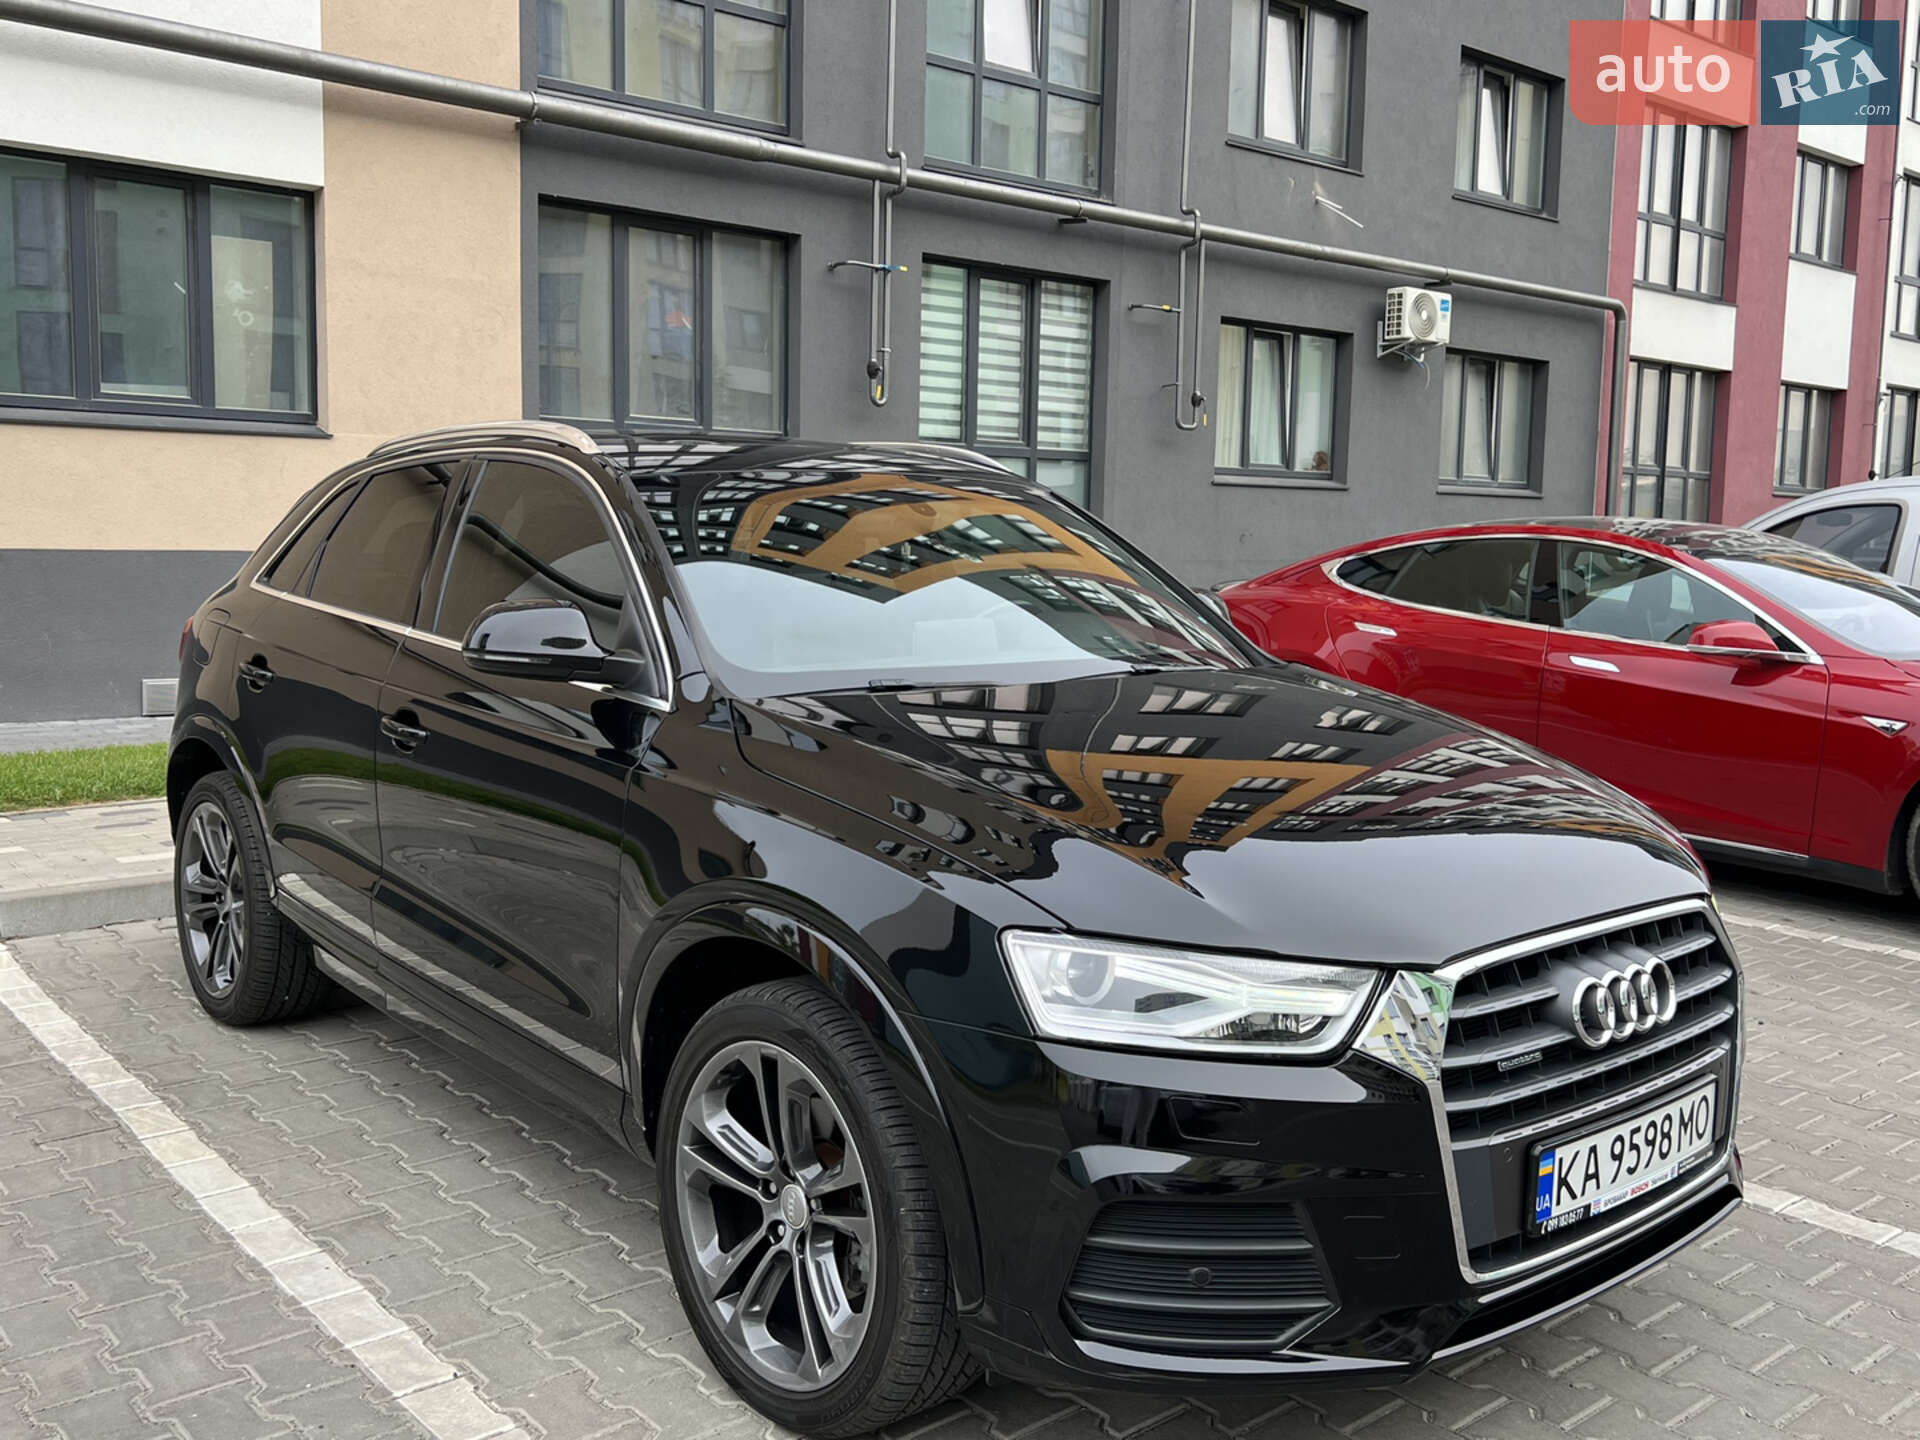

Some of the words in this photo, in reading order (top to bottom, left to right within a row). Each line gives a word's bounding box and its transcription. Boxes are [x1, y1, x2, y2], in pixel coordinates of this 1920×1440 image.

[1555, 1143, 1601, 1207] KA
[1609, 1112, 1673, 1185] 9598
[1676, 1094, 1710, 1153] MO
[1535, 1192, 1551, 1212] UA
